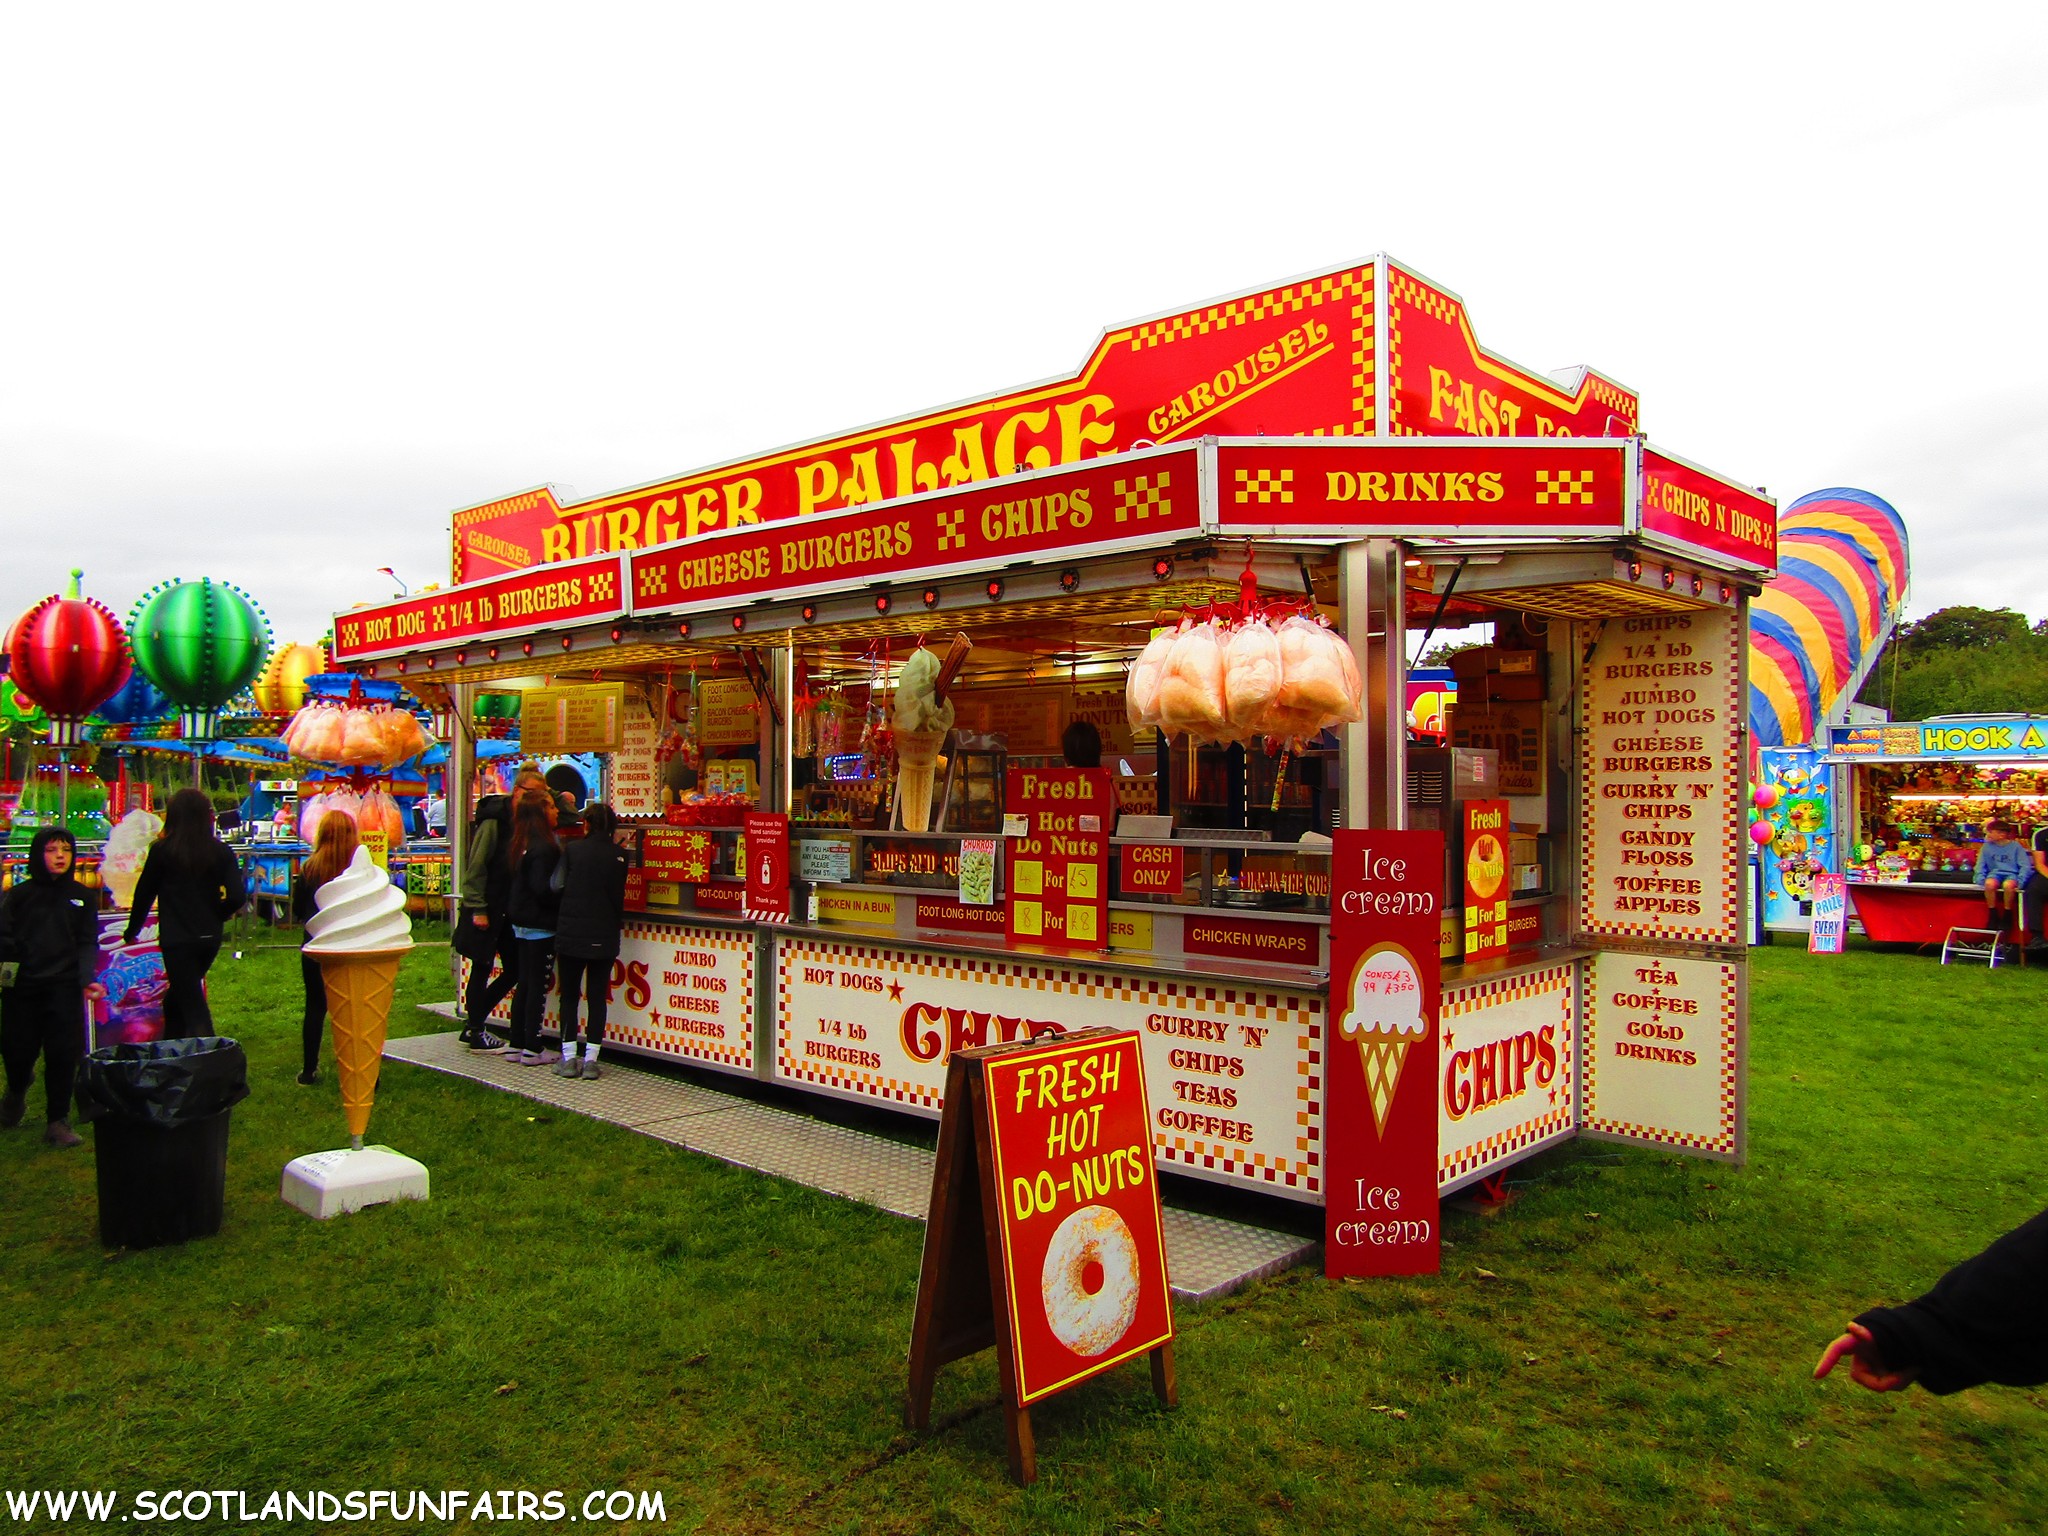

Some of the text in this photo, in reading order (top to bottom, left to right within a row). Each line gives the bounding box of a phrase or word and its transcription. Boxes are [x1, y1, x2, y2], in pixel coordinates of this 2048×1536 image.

[1147, 319, 1329, 435] CAROUSEL
[1428, 365, 1521, 437] FAST
[541, 394, 1118, 563] BURGER PALACE
[1326, 471, 1504, 503] DRINKS
[981, 488, 1093, 541] CHIPS
[1662, 482, 1761, 546] CHIPS N DIPS
[468, 530, 531, 565] CAROUSEL
[678, 521, 912, 590] CHEESE BURGERS
[451, 598, 473, 627] 1/4
[500, 580, 582, 619] BURGERS
[366, 610, 426, 643] HOT DOG
[1624, 615, 1692, 633] CHIPS
[1624, 644, 1656, 659] 1/4
[1605, 661, 1714, 679] BURGERS
[708, 685, 722, 695] FOOT
[724, 684, 739, 694] LONG
[1621, 689, 1697, 705] JUMBO
[1602, 708, 1716, 724] HOT DOGS
[1612, 736, 1704, 752] CHEESE
[1924, 725, 2013, 751] HOOK
[2020, 724, 2045, 750] A
[1603, 756, 1713, 772] BURGERS
[1022, 774, 1094, 799] Fresh
[1602, 783, 1678, 799] CURRY
[1038, 811, 1075, 832] Hot
[1471, 808, 1501, 830] Fresh
[1622, 803, 1692, 820] CHIPS
[963, 840, 994, 850] CHURROS
[1015, 835, 1098, 856] Do Nuts
[1478, 839, 1494, 856] Hot
[1620, 830, 1695, 847] CANDY
[1132, 847, 1172, 863] CASH
[1361, 848, 1407, 882] Ice
[1621, 850, 1694, 867] FLOSS
[626, 874, 642, 885] ASH
[1019, 866, 1031, 885] 4
[1045, 870, 1064, 888] For
[1133, 869, 1170, 886] ONLY
[1468, 862, 1480, 881] Do
[1484, 862, 1504, 878] Nuts
[648, 885, 671, 895] CURRY
[1614, 876, 1702, 896] TOFFEE
[755, 896, 769, 904] Thank
[853, 901, 862, 911] IN
[863, 902, 870, 912] A
[871, 902, 891, 913] BUN
[1341, 890, 1434, 915] cream
[1614, 895, 1701, 915] APPLES
[1815, 895, 1843, 916] PRIZE
[918, 905, 940, 917] FOOT
[941, 907, 964, 919] LONG
[966, 909, 983, 921] HOT
[1023, 907, 1031, 928] 8
[1044, 911, 1064, 929] For
[1479, 908, 1494, 923] For
[1508, 916, 1537, 932] BURGERS
[1814, 920, 1840, 934] EVERY
[1192, 928, 1306, 951] CHICKEN WRAPS
[1479, 932, 1494, 949] For
[1816, 937, 1836, 951] TIME
[673, 950, 717, 968] JUMBO
[662, 970, 727, 993] HOT DOGS
[803, 966, 884, 993] HOT DOGS
[1365, 970, 1392, 979] CONES
[1635, 968, 1679, 986] TEA
[1363, 981, 1376, 993] 99
[669, 993, 720, 1014] CHEESE
[1612, 992, 1699, 1015] COFFEE
[664, 1015, 725, 1039] BURGERS
[818, 1016, 842, 1037] 1/4
[1146, 1013, 1230, 1043] CURRY
[1627, 1021, 1684, 1042] COLD
[804, 1040, 882, 1070] BURGERS
[1167, 1048, 1245, 1079] CHIPS
[1615, 1041, 1698, 1066] DRINKS
[1016, 1050, 1122, 1114] FRESH
[1443, 1023, 1557, 1122] CHIPS
[1172, 1080, 1238, 1110] TEAS
[1047, 1104, 1105, 1160] HOT
[1156, 1107, 1254, 1145] COFFEE
[1012, 1145, 1146, 1221] DO-NUTS
[1354, 1178, 1401, 1211] Ice
[1335, 1219, 1430, 1246] cream
